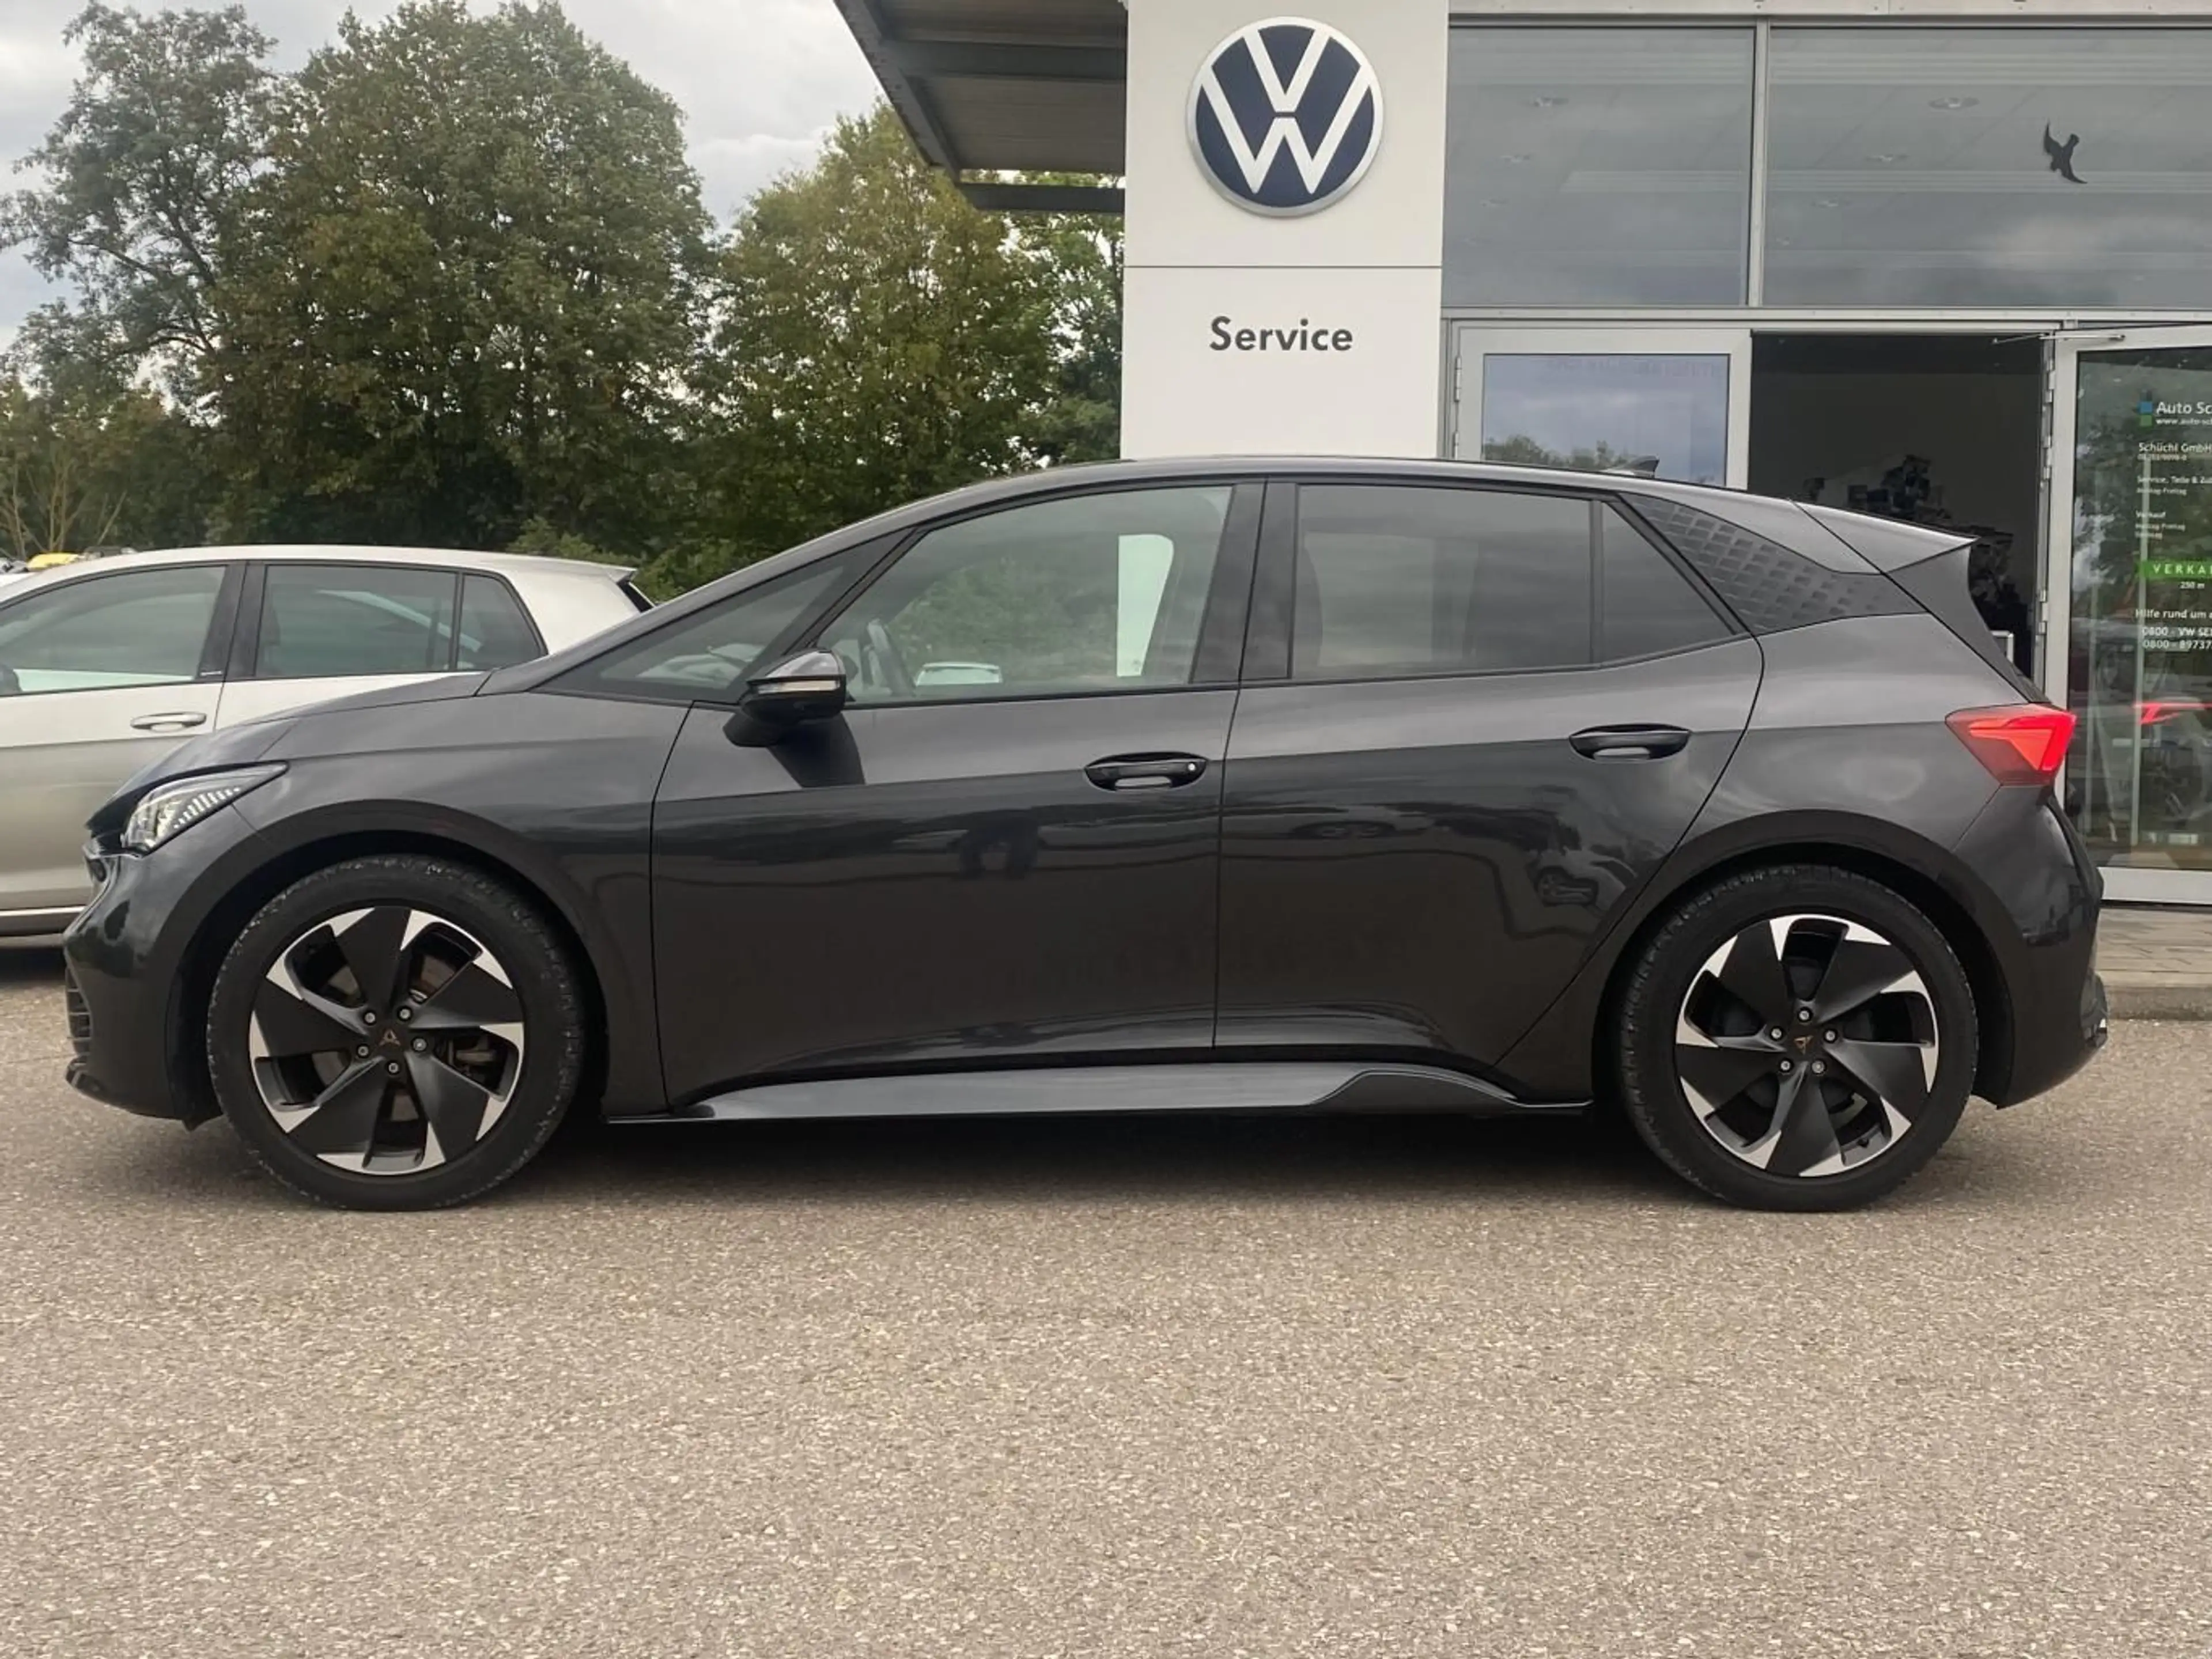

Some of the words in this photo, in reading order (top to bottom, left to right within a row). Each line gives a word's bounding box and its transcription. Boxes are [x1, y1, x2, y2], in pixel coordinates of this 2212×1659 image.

[1209, 316, 1353, 351] Service
[2156, 402, 2192, 415] Auto
[2135, 608, 2160, 618] Hilfe
[2162, 609, 2187, 619] rund
[2178, 626, 2195, 636] VW
[2179, 639, 2212, 650] 89737
